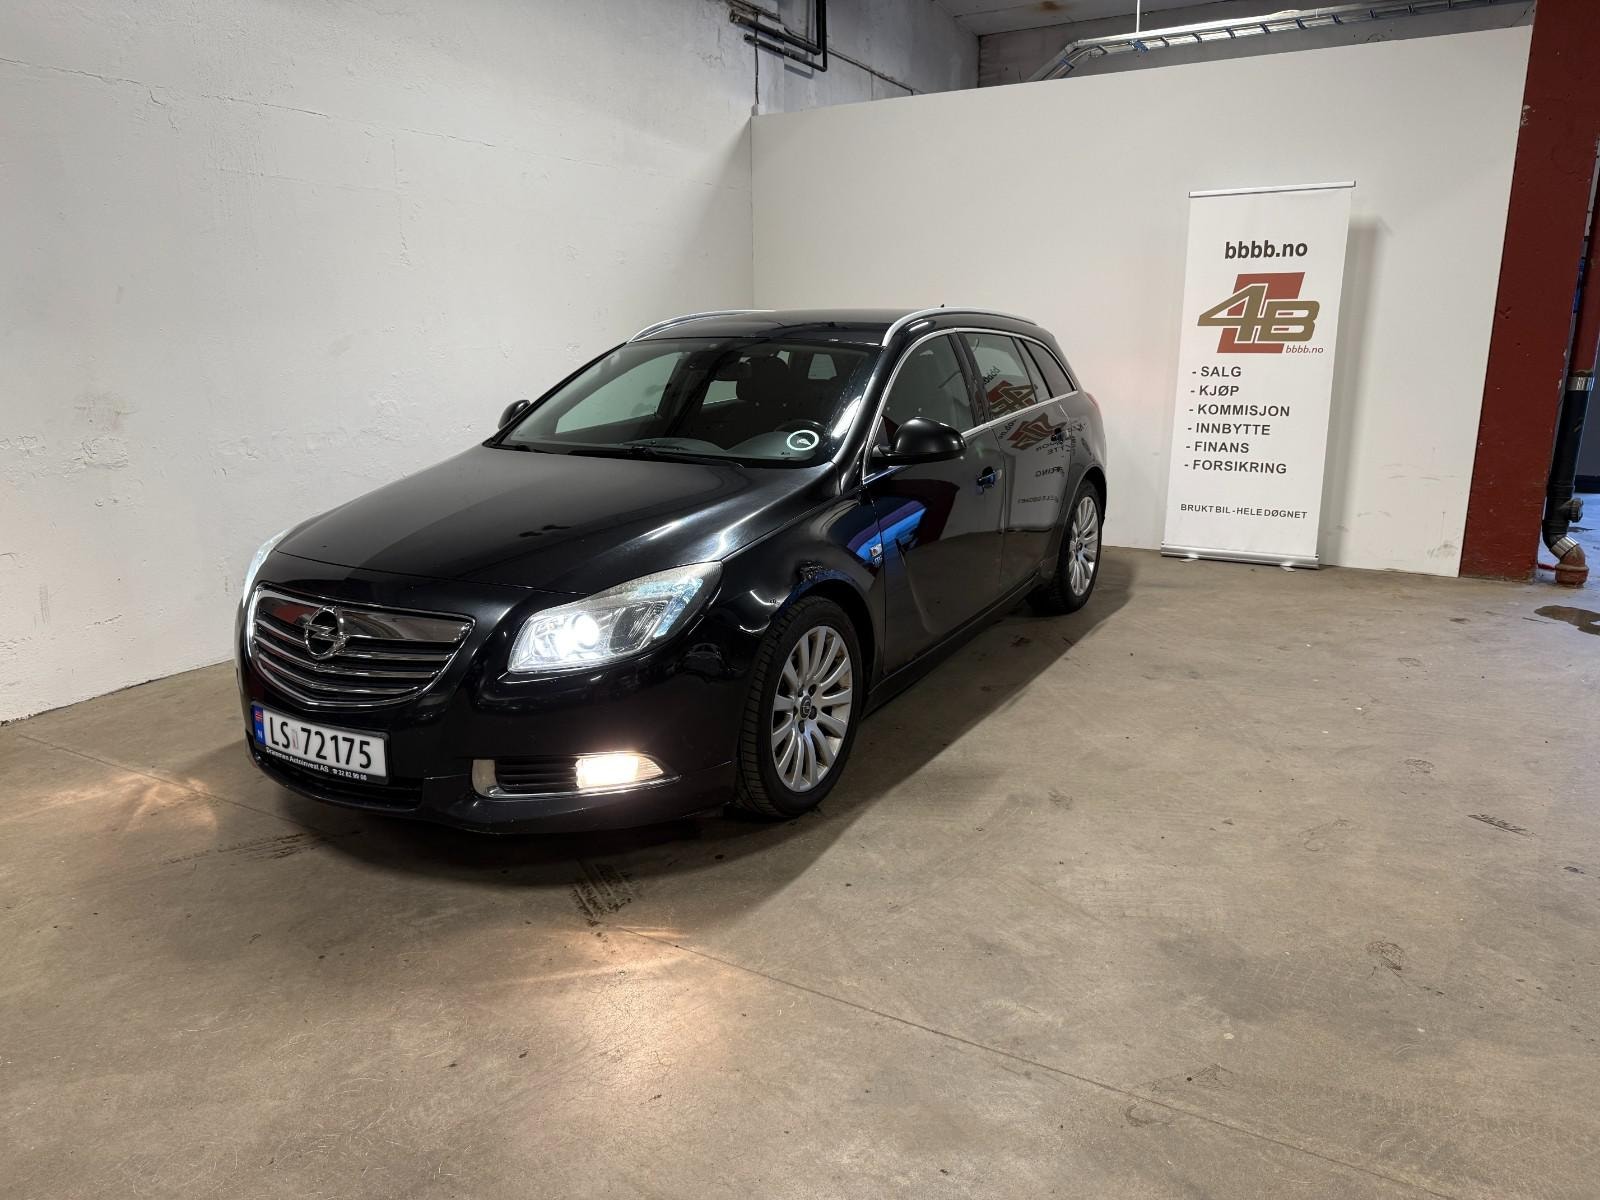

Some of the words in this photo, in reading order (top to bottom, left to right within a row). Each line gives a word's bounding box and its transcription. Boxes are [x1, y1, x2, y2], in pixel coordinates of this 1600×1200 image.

[1224, 239, 1308, 259] bbbb.no
[1285, 344, 1324, 354] bbbb.no
[1200, 366, 1242, 377] SALG
[1199, 385, 1240, 397] KJØP
[1197, 404, 1290, 417] KOMMISJON
[1195, 422, 1271, 435] INNBYTTE
[1194, 441, 1250, 454] FINANS
[1192, 459, 1287, 474] FORSIKRING
[1180, 503, 1214, 513] BRUKT
[1215, 506, 1231, 514] BIL
[1236, 507, 1262, 516] HELE
[1264, 509, 1308, 519] DØGNET
[269, 716, 291, 749] LS
[301, 727, 372, 769] 72175
